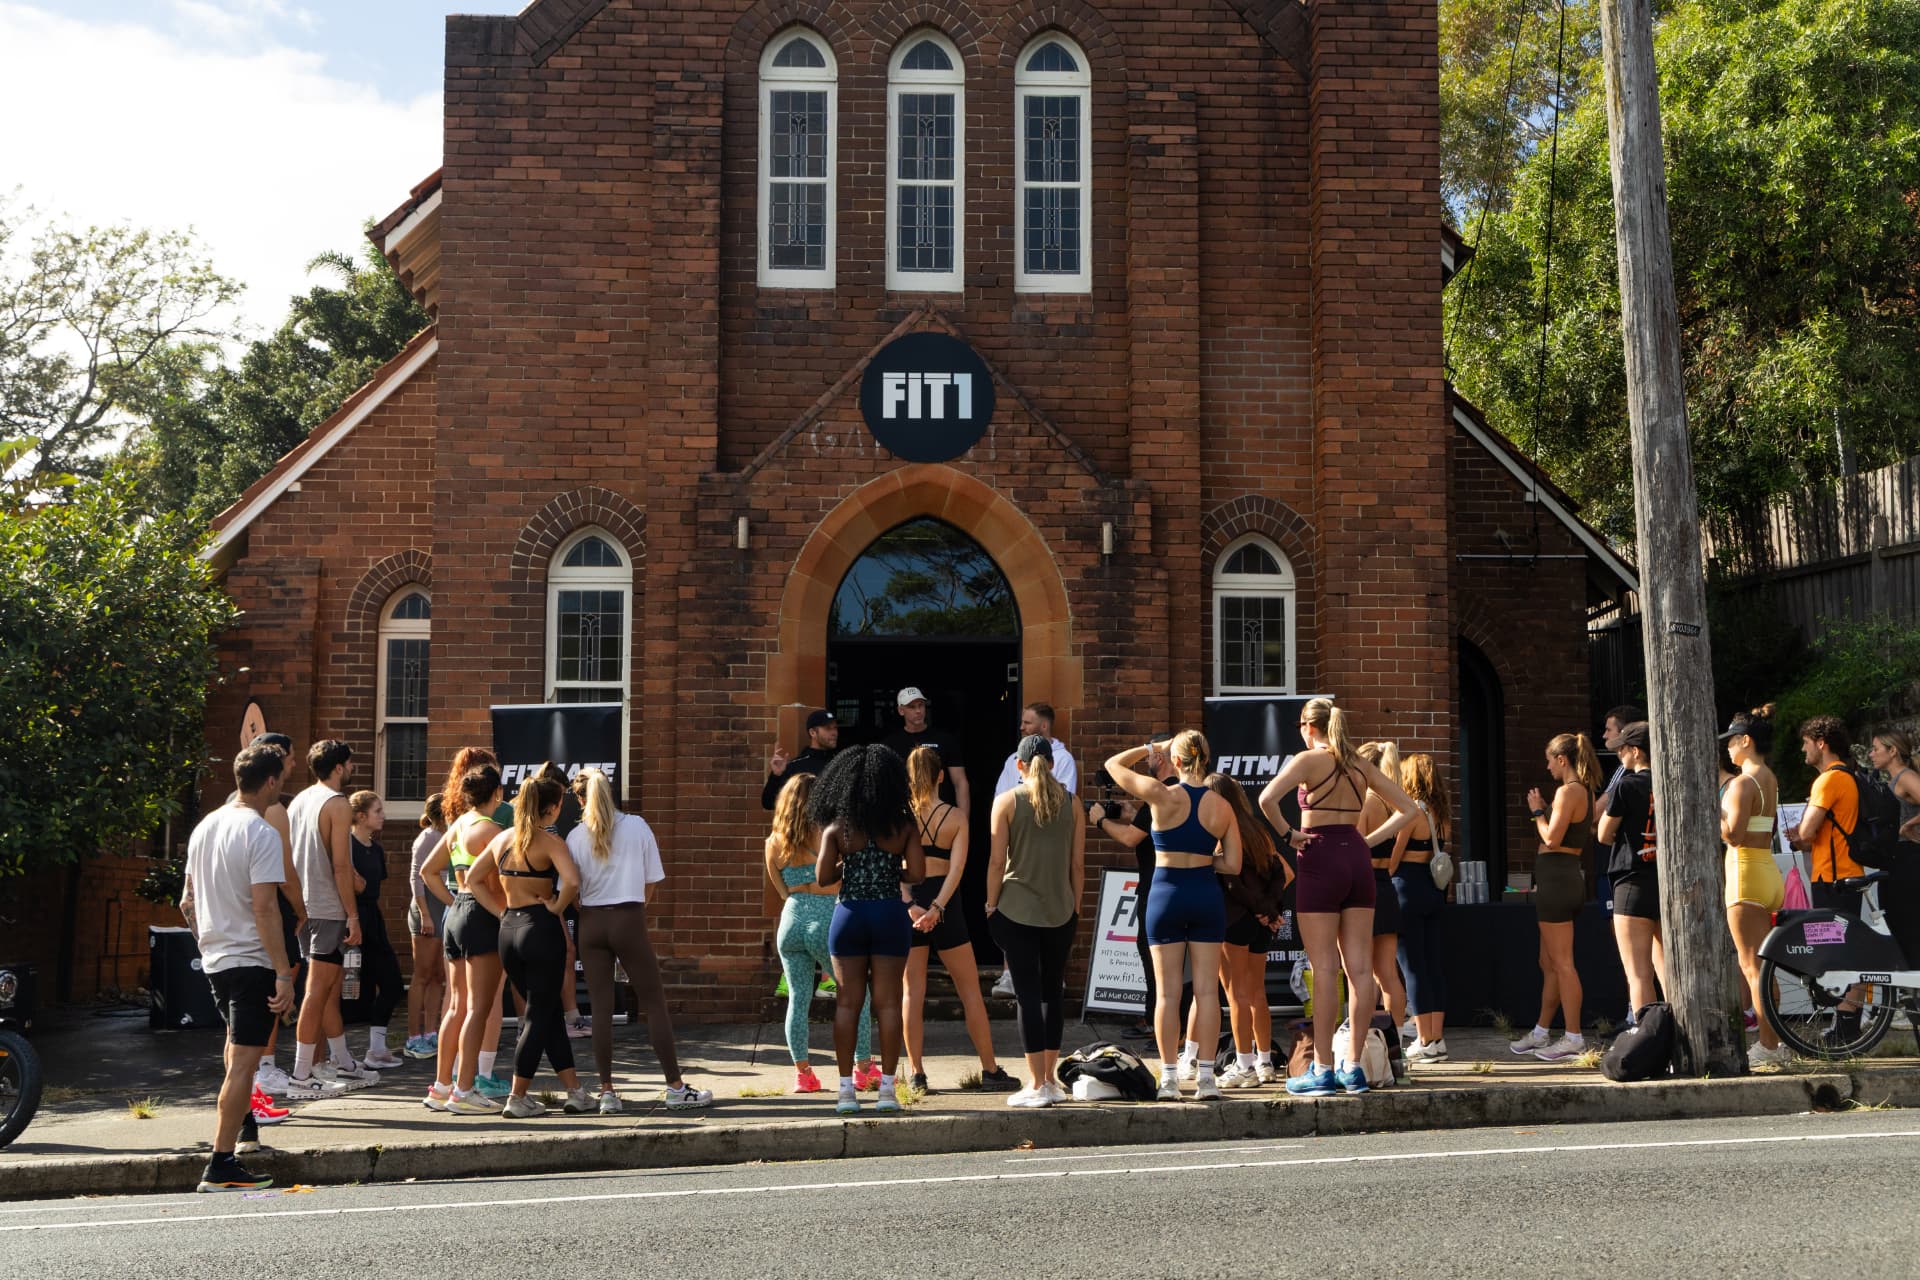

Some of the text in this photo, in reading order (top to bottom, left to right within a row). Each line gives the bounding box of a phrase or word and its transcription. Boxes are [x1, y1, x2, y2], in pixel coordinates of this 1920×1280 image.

[882, 372, 972, 419] FIT1
[1786, 944, 1814, 954] Lime
[1266, 950, 1286, 961] STER
[1098, 971, 1147, 984] www.fit1.co
